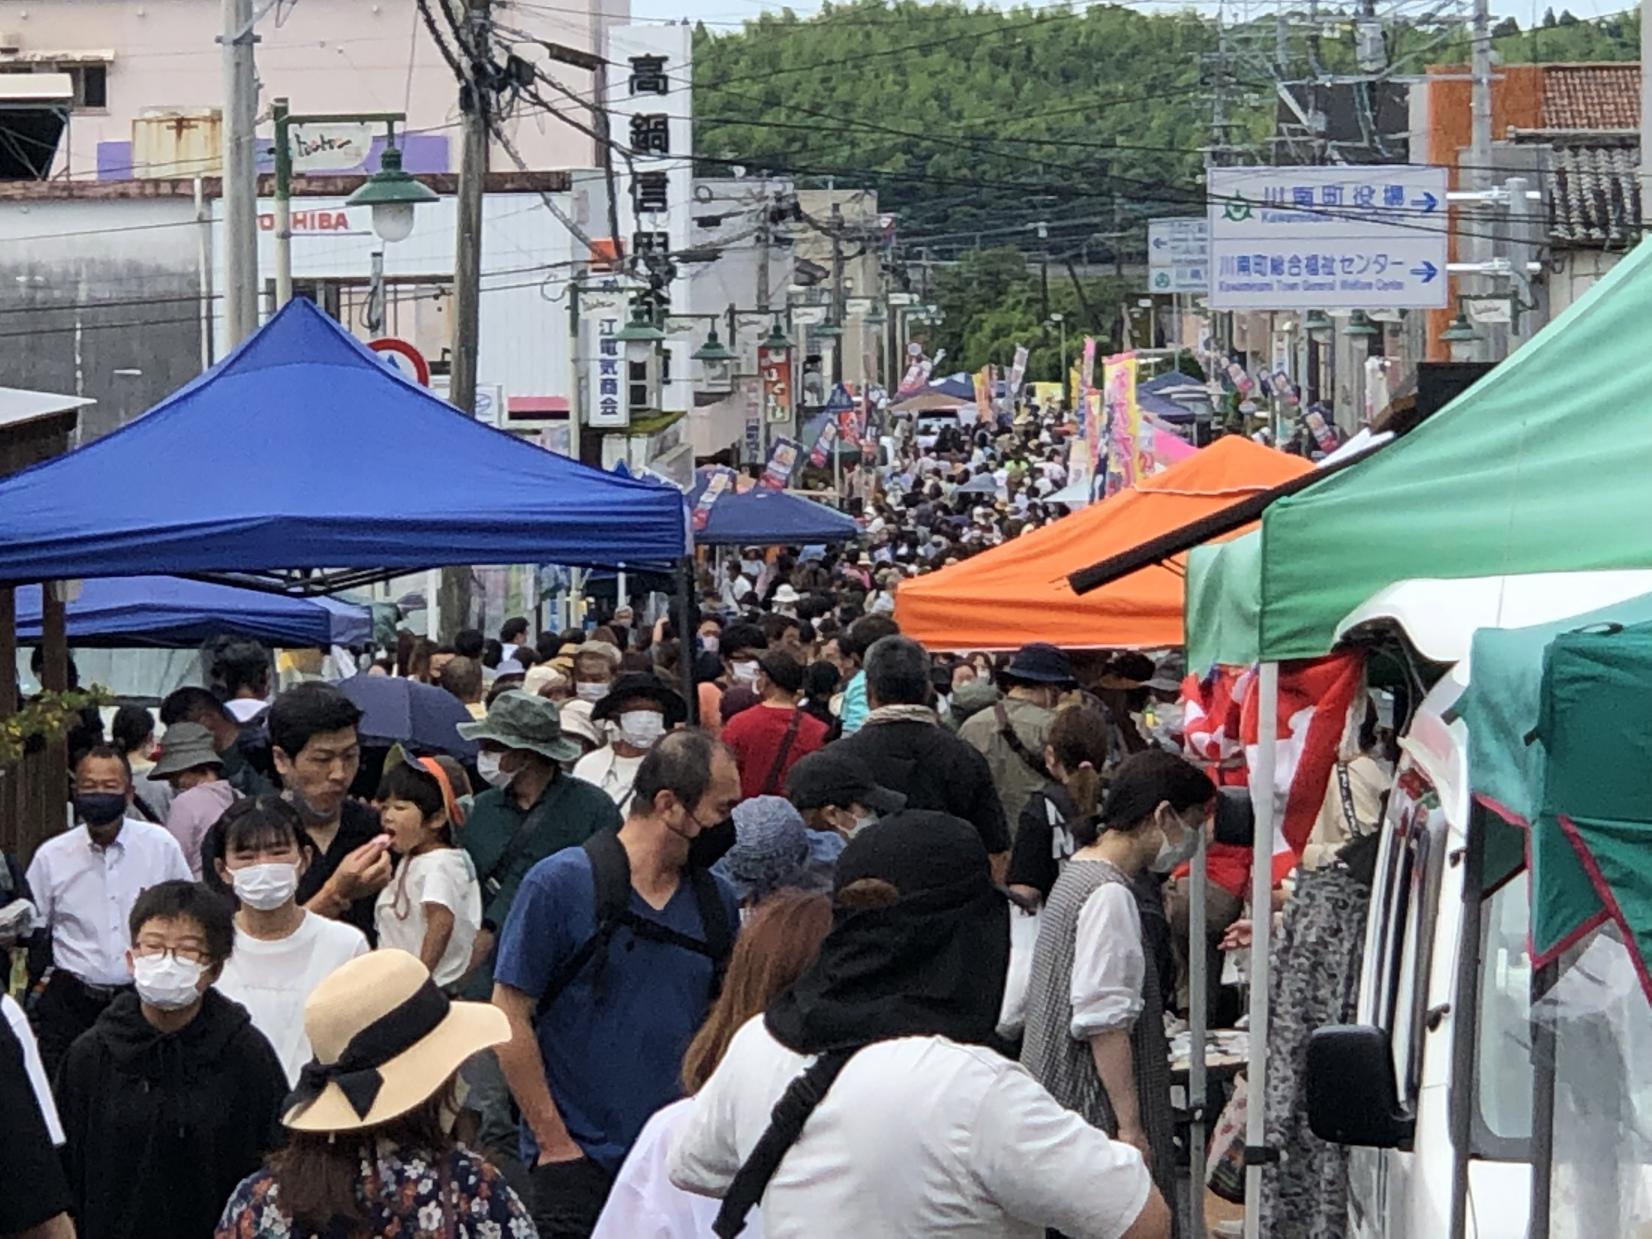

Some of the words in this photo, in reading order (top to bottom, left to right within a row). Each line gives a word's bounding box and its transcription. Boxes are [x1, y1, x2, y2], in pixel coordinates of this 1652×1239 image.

[257, 211, 349, 231] OHIBA
[1219, 254, 1404, 277] 川南町総合福祉センター
